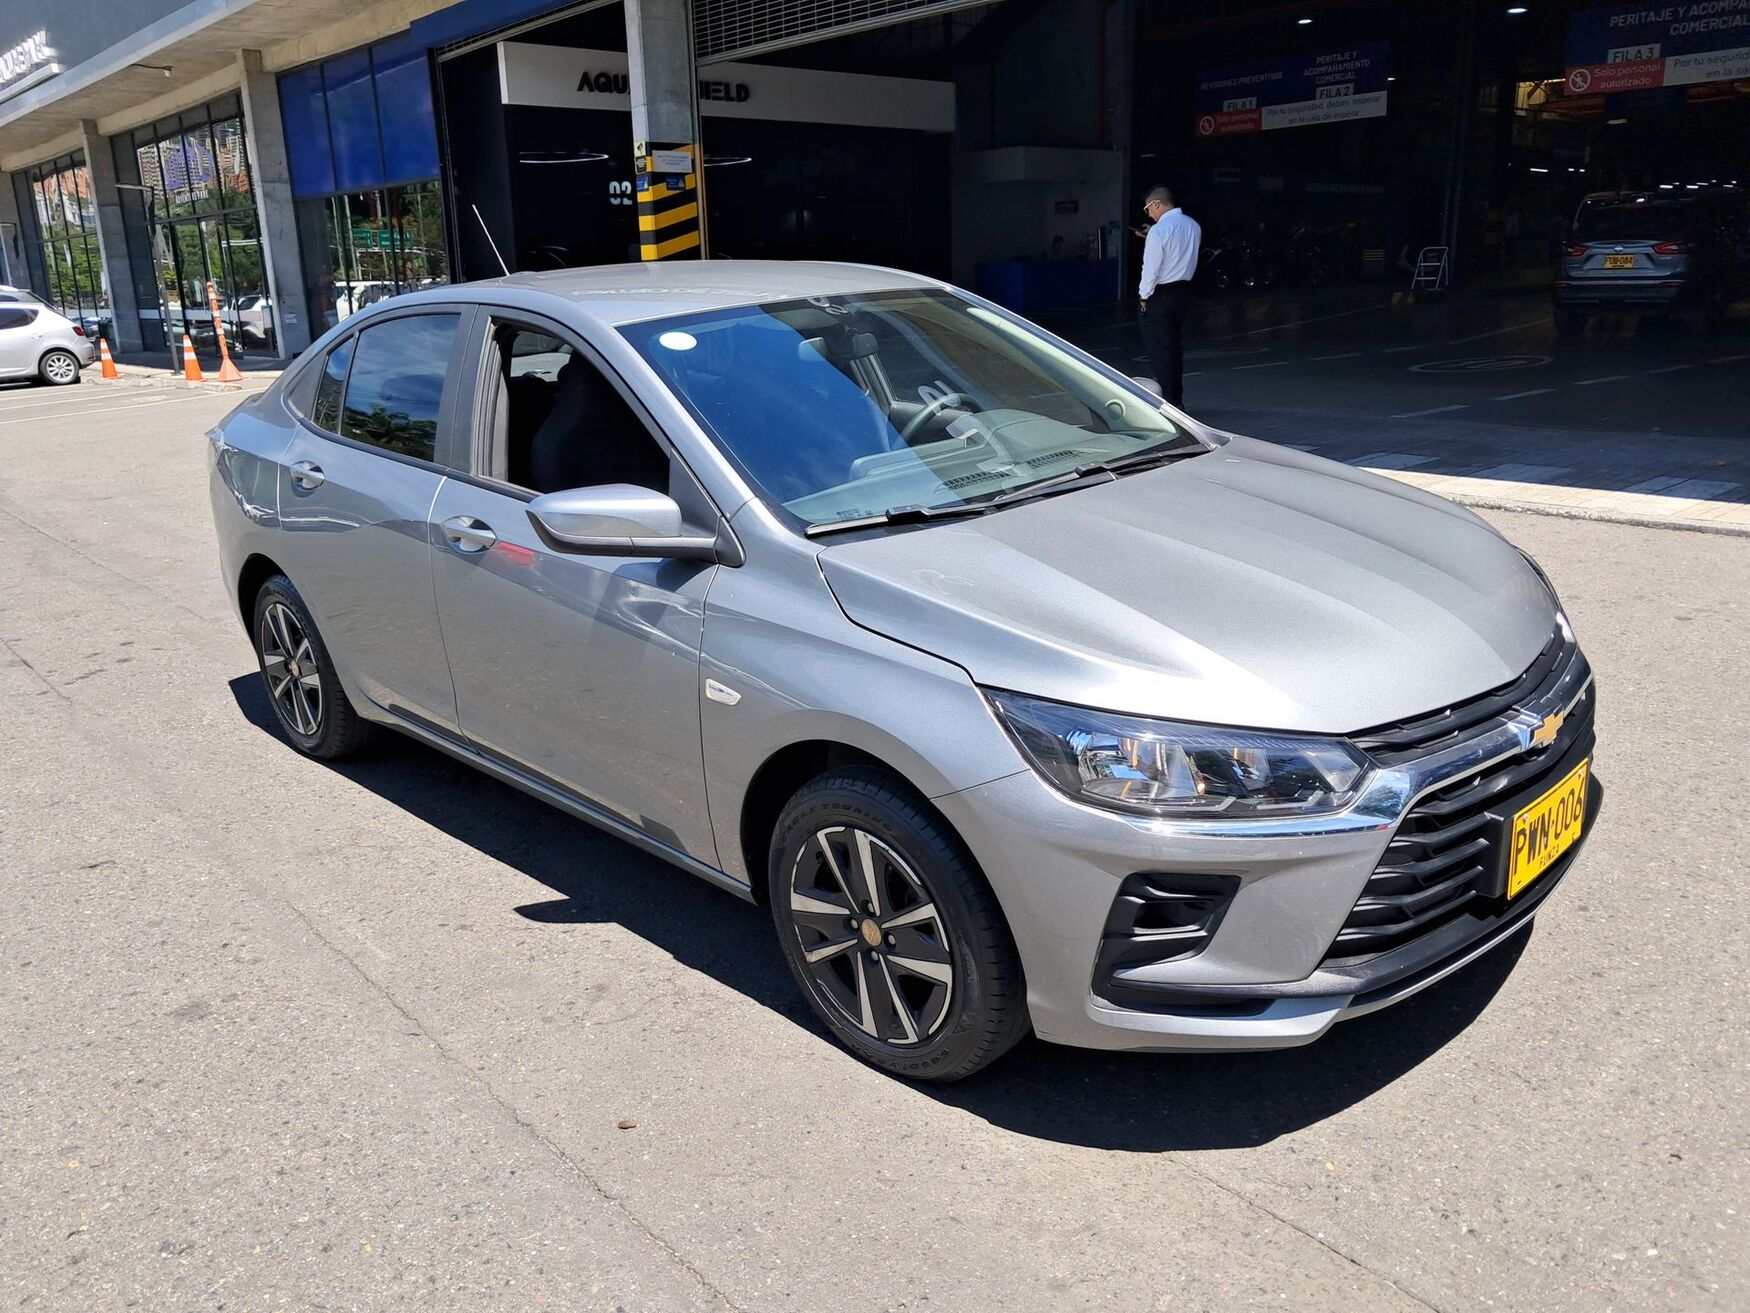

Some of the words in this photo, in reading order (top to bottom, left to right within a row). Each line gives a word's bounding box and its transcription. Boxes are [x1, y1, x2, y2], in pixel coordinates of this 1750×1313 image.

[1609, 8, 1674, 28] PERITAJE
[1678, 6, 1688, 18] Y
[1688, 0, 1750, 17] ACOMPA
[1670, 13, 1750, 36] COMERCIAL
[1613, 49, 1643, 63] FILA
[1646, 48, 1654, 59] 3
[1617, 63, 1661, 77] personal
[577, 72, 630, 94] AQU
[1600, 77, 1652, 89] autorizado
[1320, 87, 1342, 99] FILA
[609, 181, 632, 205] 02
